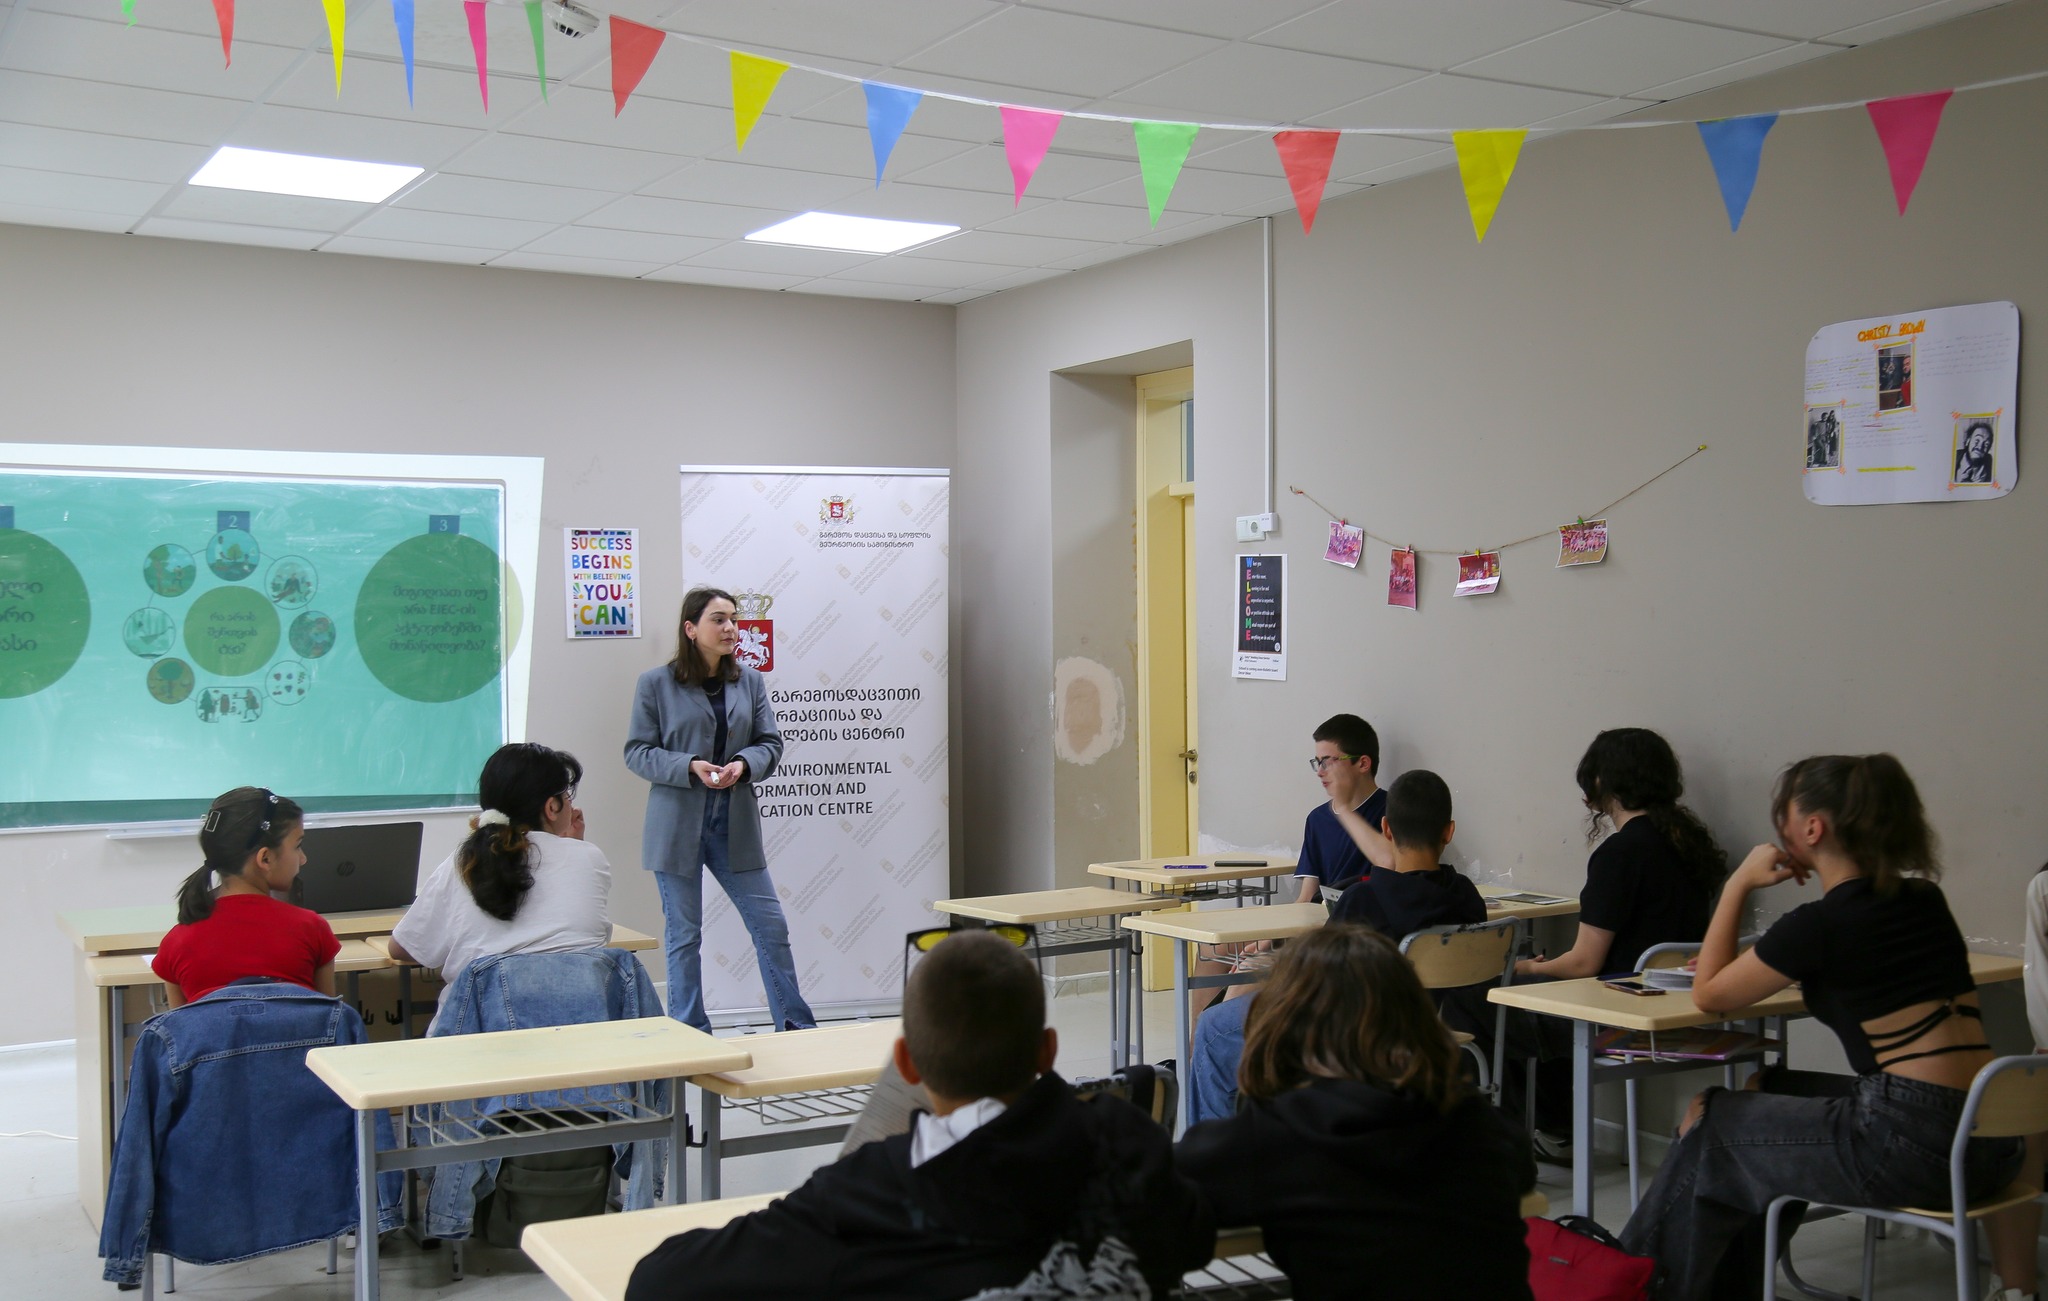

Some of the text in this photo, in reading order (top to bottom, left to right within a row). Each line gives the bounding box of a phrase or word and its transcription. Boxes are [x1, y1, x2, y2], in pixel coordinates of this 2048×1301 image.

[1857, 324, 1891, 342] CHRISTY
[229, 515, 238, 528] 2
[440, 519, 448, 532] 3
[571, 537, 632, 550] SUCCESS
[571, 555, 632, 569] BEGINS
[583, 584, 622, 601] YOU
[580, 604, 626, 625] CAN
[771, 687, 921, 703] გარემოსდაცვითი
[773, 708, 856, 723] რმაციისა
[860, 708, 883, 721] და
[842, 727, 905, 741] ცენტრი
[754, 782, 867, 798] ORMATION AND
[760, 802, 874, 818] CATION CENTRE
